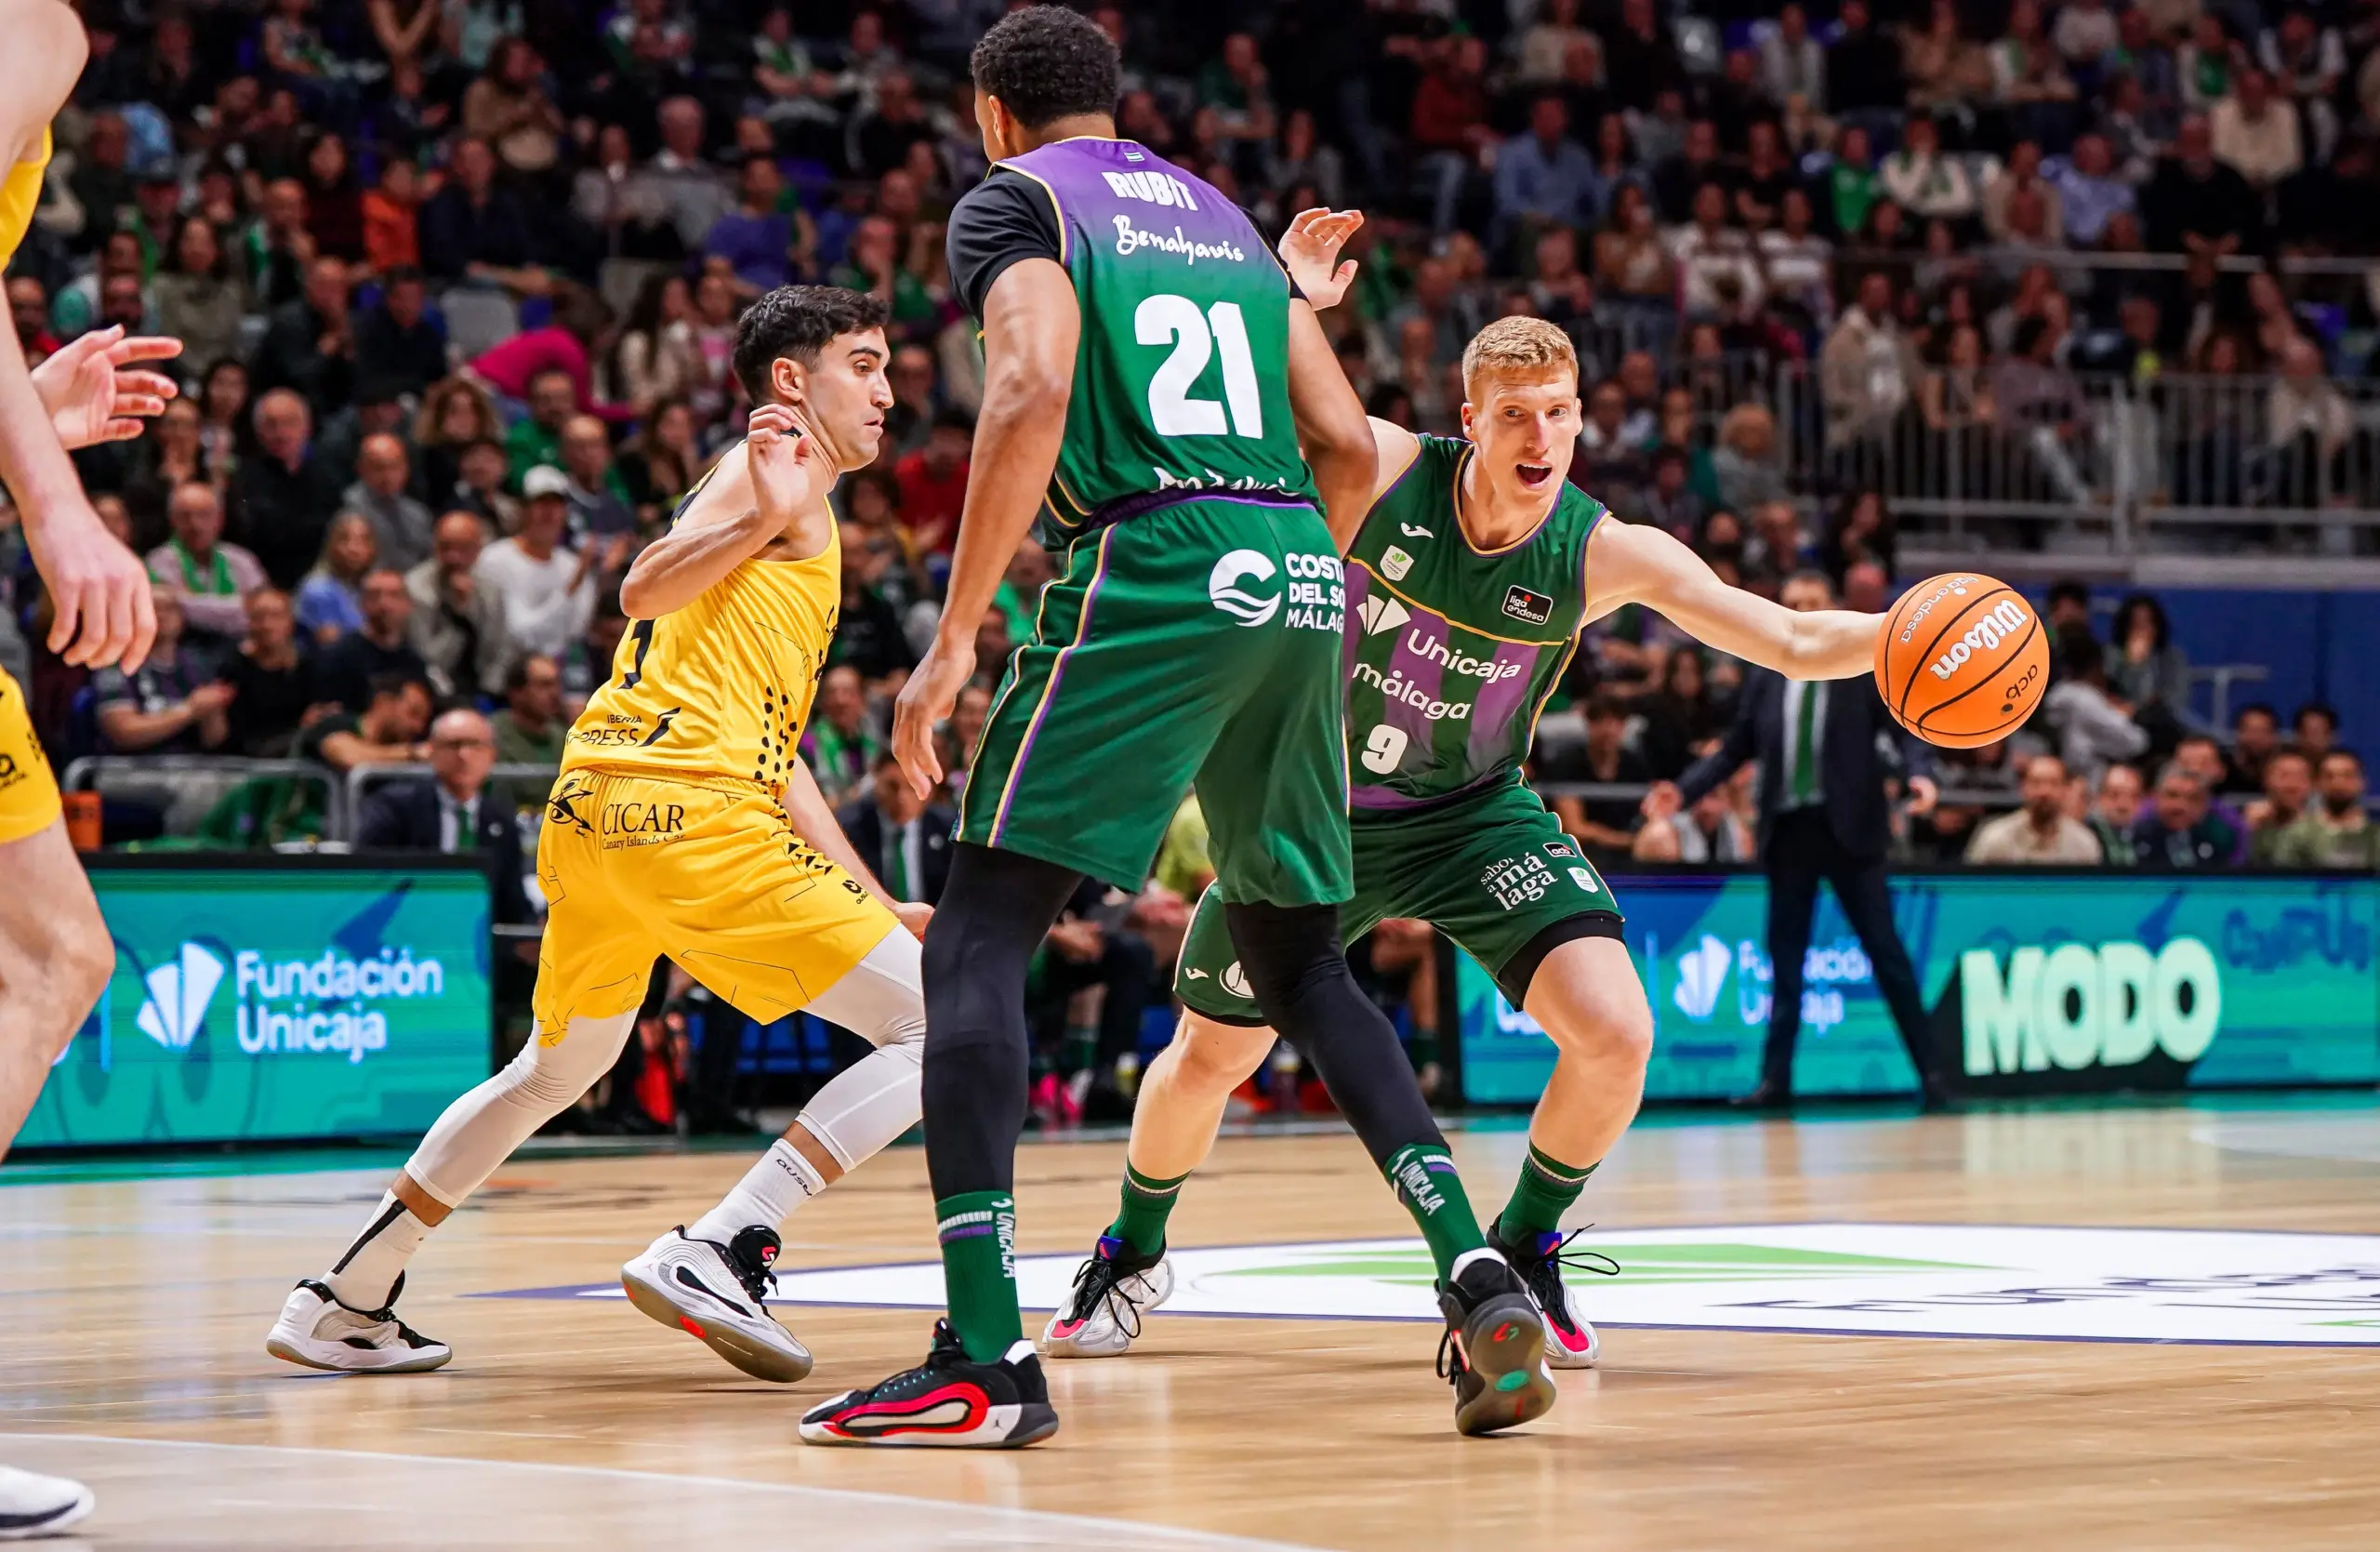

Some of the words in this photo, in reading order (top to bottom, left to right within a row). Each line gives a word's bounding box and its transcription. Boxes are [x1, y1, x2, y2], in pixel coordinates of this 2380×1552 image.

[1101, 171, 1198, 211] RUBIT
[1133, 293, 1263, 440] 21
[1285, 604, 1345, 634] MÁLAG
[1289, 582, 1329, 605] DEL
[1329, 585, 1346, 612] SO
[1507, 604, 1544, 622] endesa
[1509, 594, 1527, 608] liga
[1900, 587, 1950, 644] endesa
[1407, 628, 1523, 684] Unicaja
[1929, 599, 2028, 681] Wilson
[1352, 662, 1472, 721] málaga
[2005, 664, 2038, 700] acb
[607, 714, 642, 724] IBERIA
[1361, 723, 1408, 775] 9
[602, 803, 684, 835] CICAR
[602, 838, 625, 852] Canary
[627, 835, 660, 847] Islands
[1495, 870, 1559, 911] laga
[236, 948, 443, 1000] Fundación
[1959, 935, 2223, 1078] MODO
[236, 1009, 388, 1064] Unicaja
[1398, 1160, 1446, 1217] UNICAJA
[996, 1212, 1016, 1280] UNICAJA
